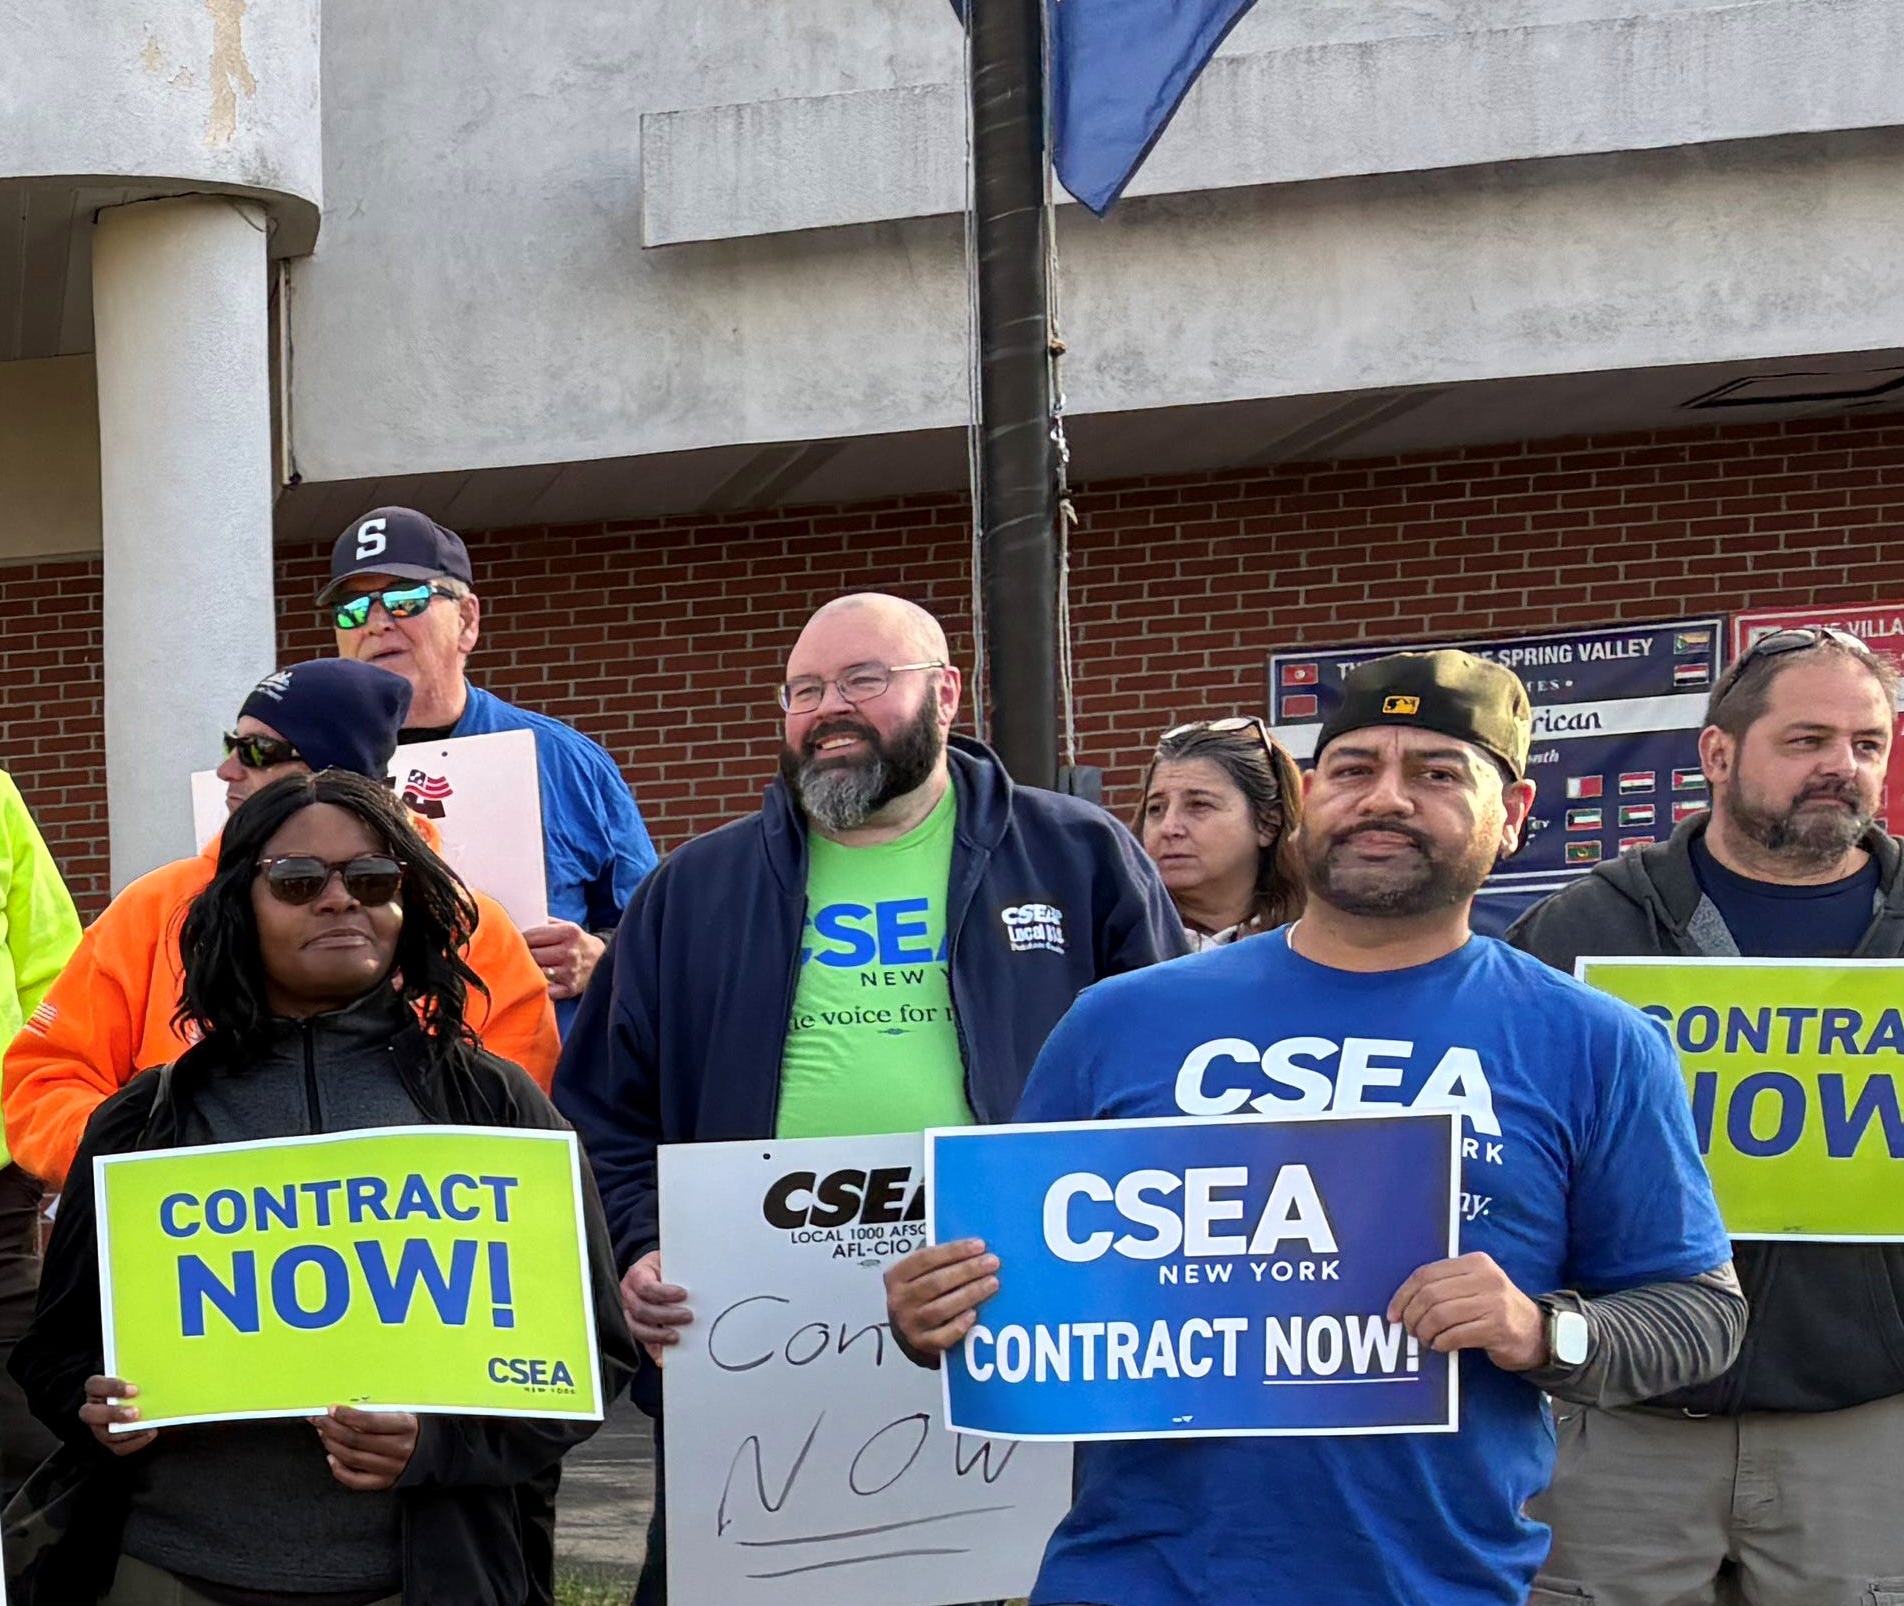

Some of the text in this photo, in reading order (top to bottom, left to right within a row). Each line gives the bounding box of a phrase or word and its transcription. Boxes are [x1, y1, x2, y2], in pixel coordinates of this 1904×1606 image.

[356, 518, 387, 561] S
[1848, 617, 1904, 638] VILLA
[1498, 644, 1573, 667] SPRING
[1578, 638, 1653, 661] VALLEY
[1533, 709, 1601, 733] rican
[801, 898, 950, 968] SE
[861, 969, 924, 987] NEW
[820, 1006, 891, 1025] voice
[900, 1004, 937, 1022] for
[1640, 1005, 1904, 1055] ONTRA
[1175, 1037, 1502, 1137] CSEA
[1462, 1137, 1503, 1165] RK
[159, 1174, 518, 1238] CONTRACT
[1043, 1164, 1338, 1263] CSEA
[1460, 1192, 1492, 1220] ny.
[791, 1222, 925, 1244] LOCAL 1000 AFSC
[832, 1239, 911, 1258] AFL-CIO
[176, 1237, 515, 1337] NOW!
[1159, 1260, 1341, 1285] NEW YORK
[965, 1314, 1418, 1383] CONTRACT NOW!
[488, 1357, 574, 1387] CSEA
[718, 1409, 1019, 1537] NOW
